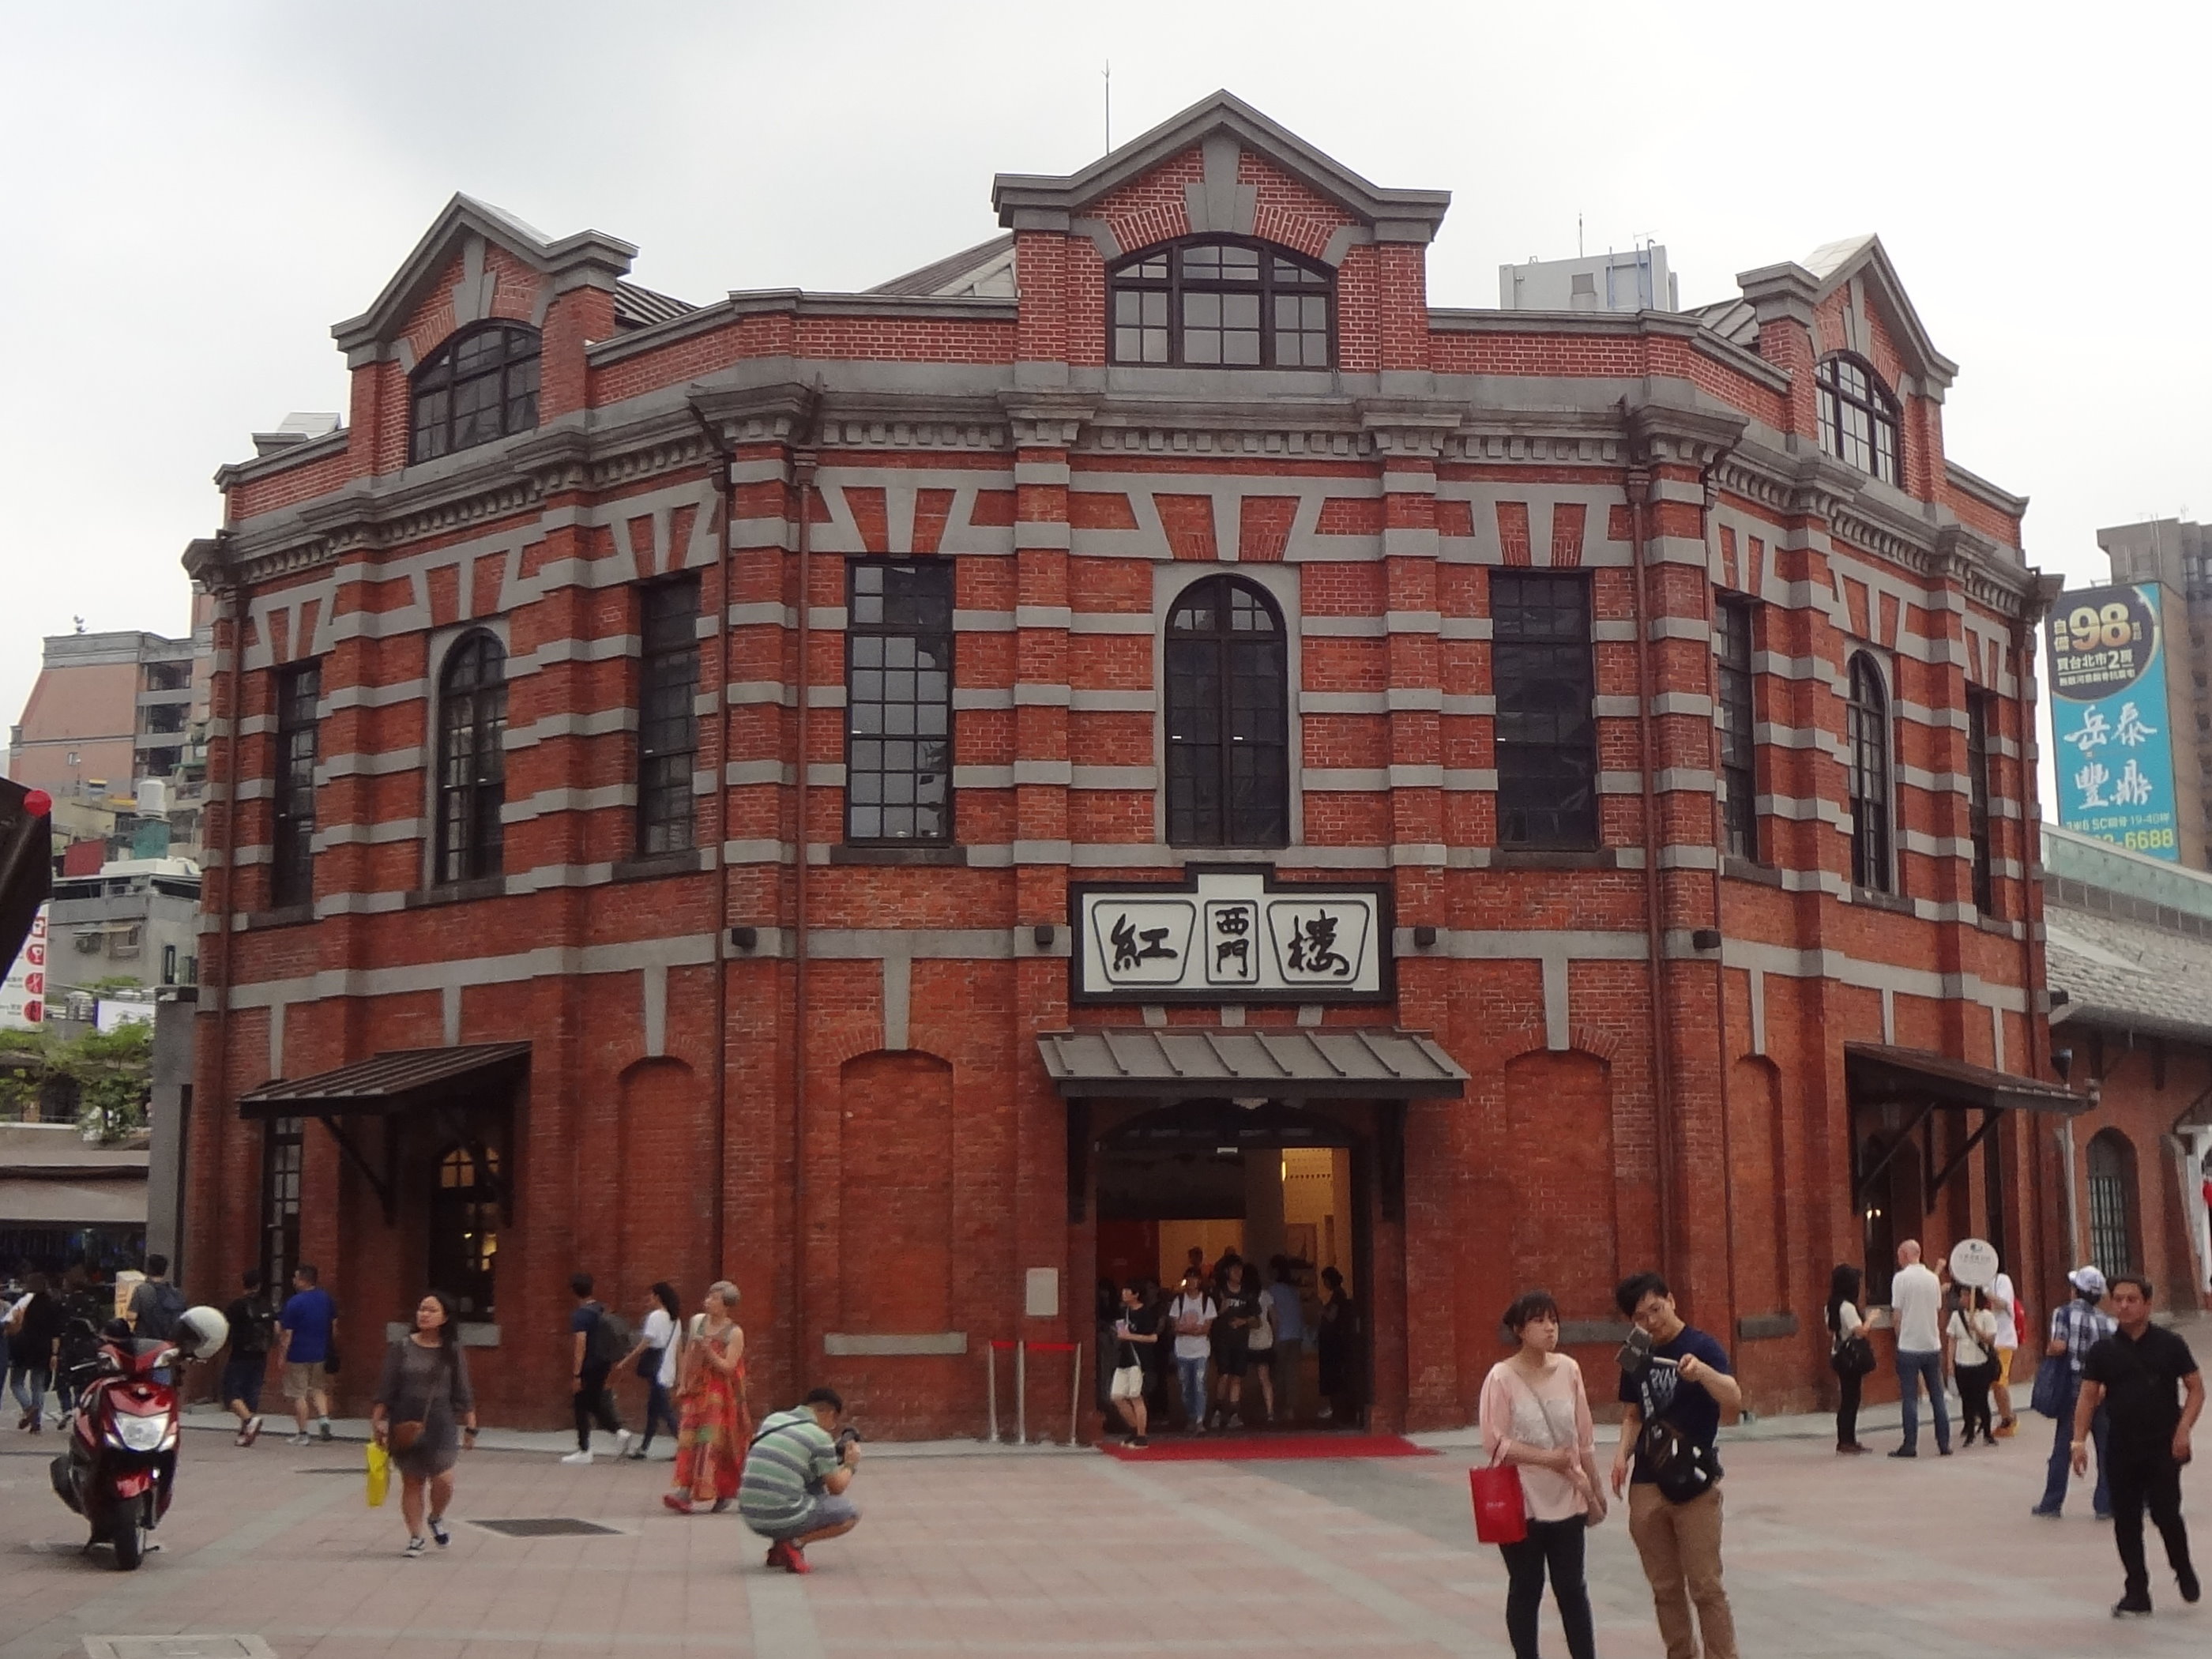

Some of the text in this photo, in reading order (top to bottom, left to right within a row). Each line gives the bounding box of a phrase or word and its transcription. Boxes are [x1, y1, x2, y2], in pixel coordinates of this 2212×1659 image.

[2069, 603, 2131, 651] 98
[1111, 913, 1178, 972] 紅
[1215, 907, 1250, 978] 西門
